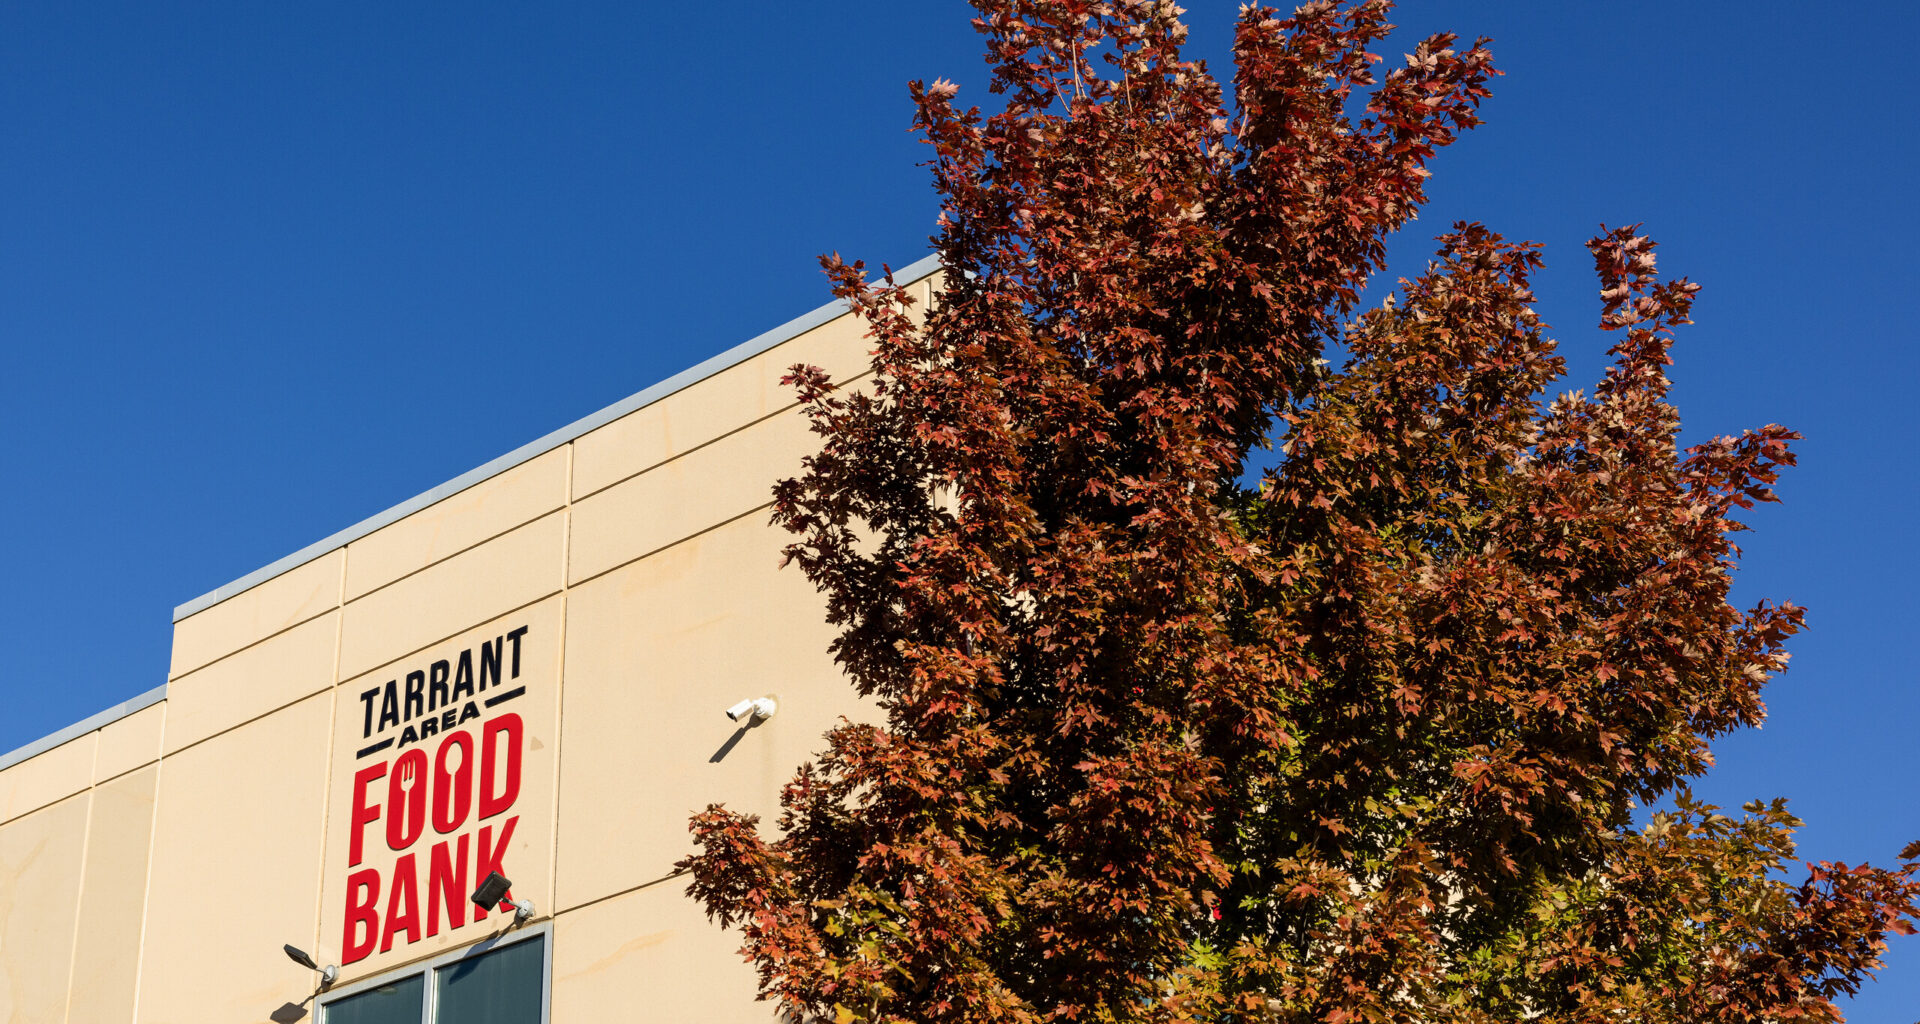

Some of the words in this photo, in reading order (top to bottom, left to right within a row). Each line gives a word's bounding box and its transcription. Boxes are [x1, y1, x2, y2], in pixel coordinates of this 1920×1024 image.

[360, 625, 529, 739] TARRANT
[397, 700, 481, 749] AREA
[348, 713, 524, 868] FOOD
[341, 815, 520, 966] BANK
